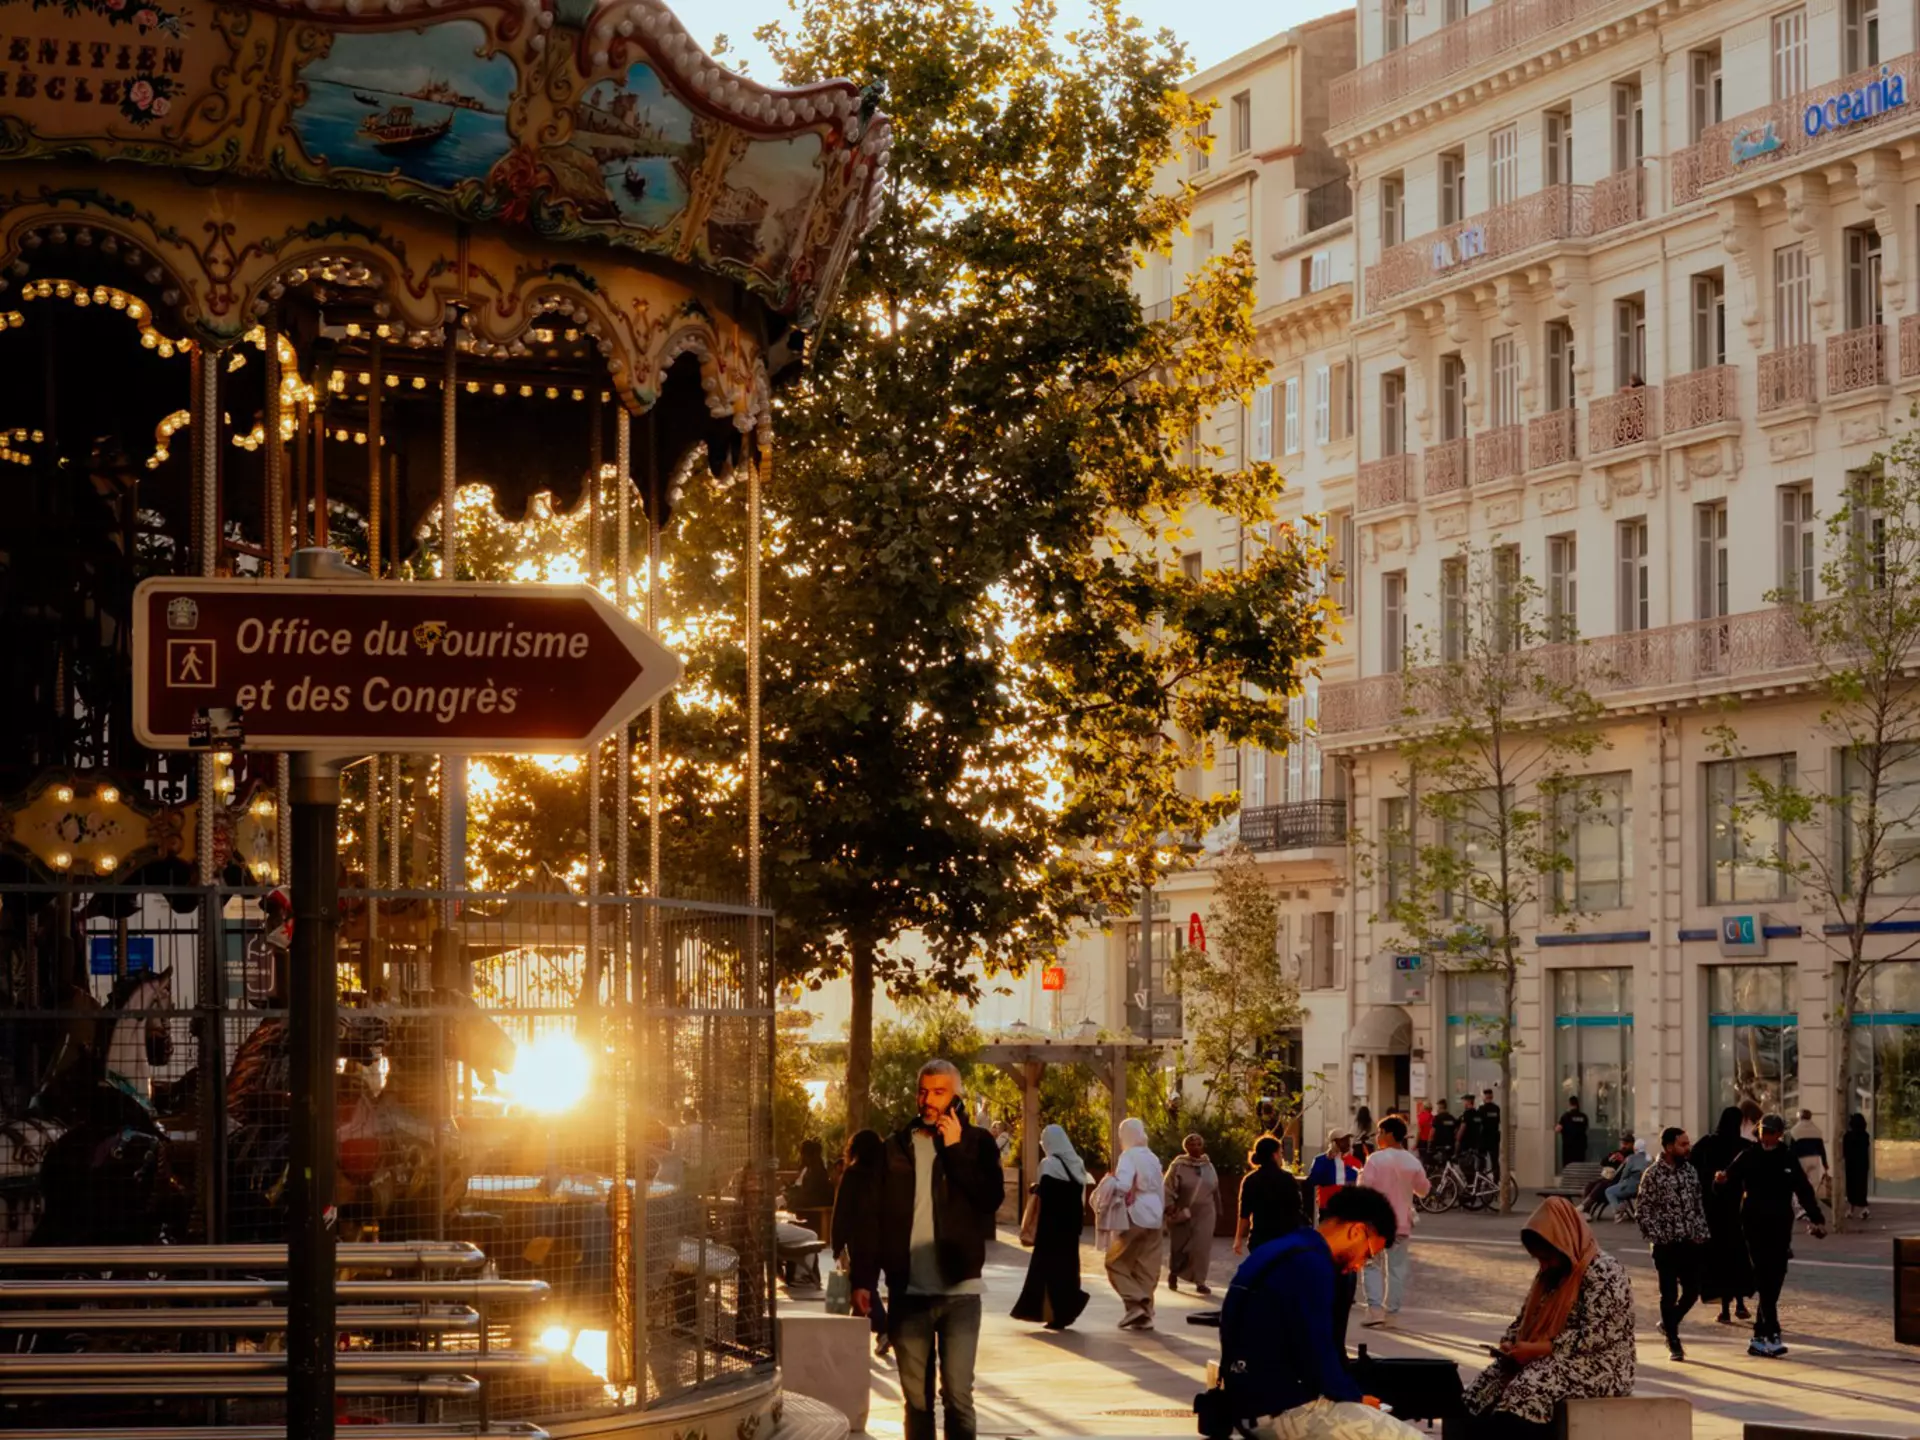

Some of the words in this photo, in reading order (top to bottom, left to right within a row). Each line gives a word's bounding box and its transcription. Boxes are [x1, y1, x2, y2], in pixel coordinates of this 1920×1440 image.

[0, 35, 183, 73] ENITIEN
[1804, 66, 1905, 137] oceania
[236, 617, 353, 656] Office
[363, 619, 409, 657] du
[421, 620, 590, 659] Tourisme
[236, 678, 276, 712] et
[285, 675, 352, 713] des
[362, 676, 519, 724] Congrès
[1726, 920, 1752, 940] CIC
